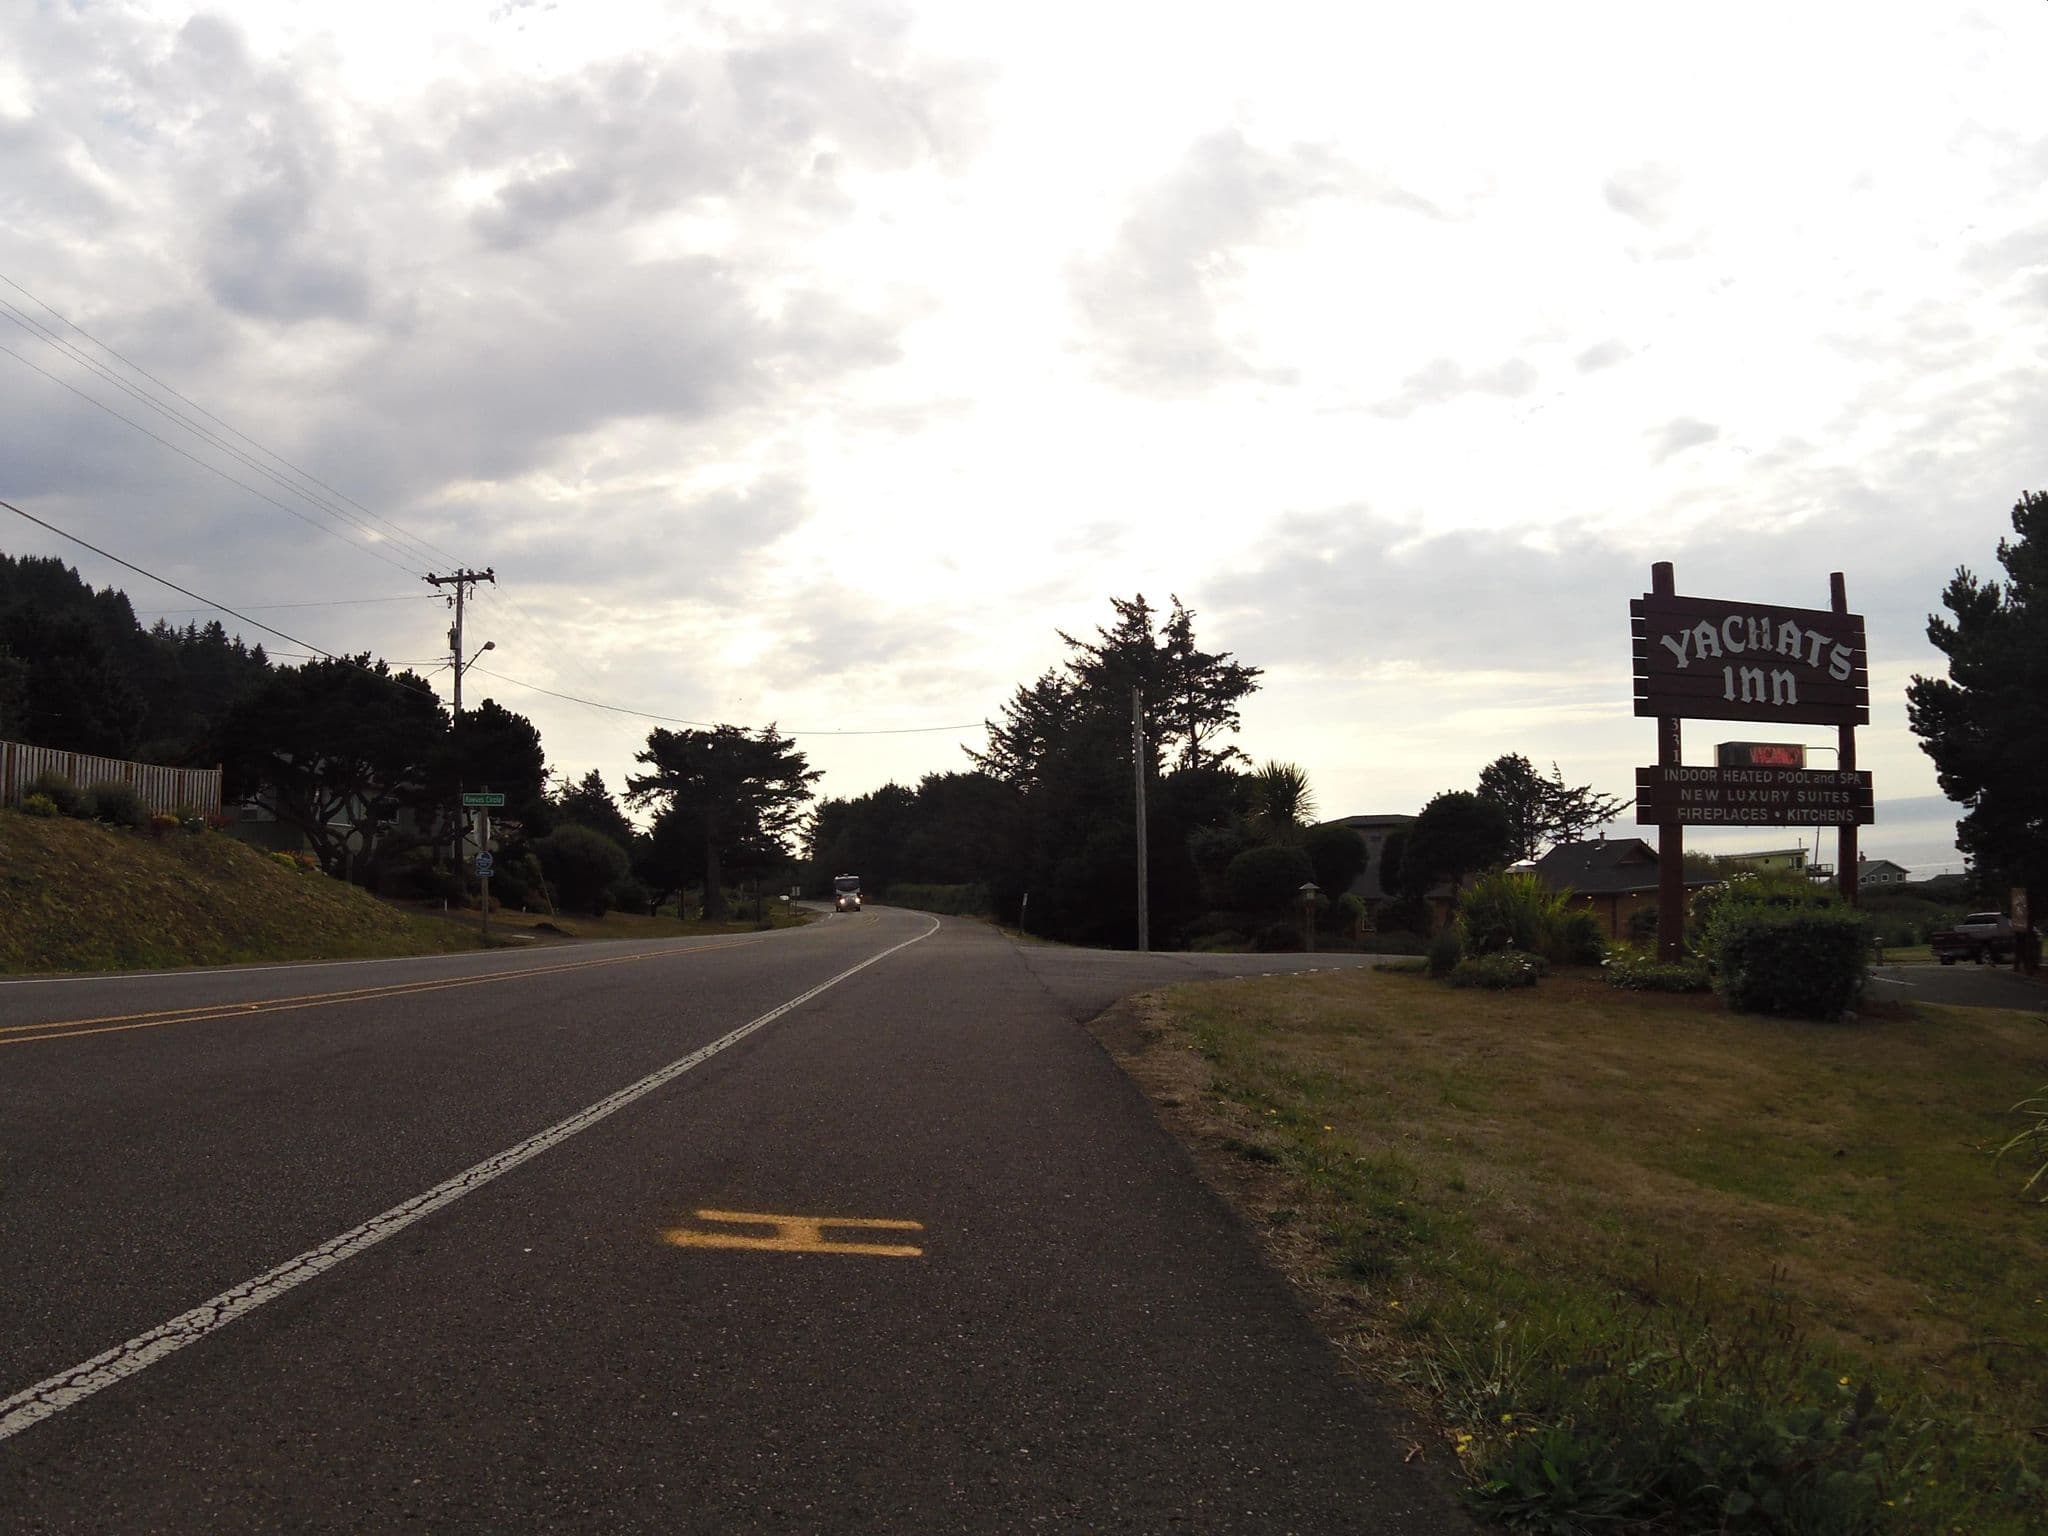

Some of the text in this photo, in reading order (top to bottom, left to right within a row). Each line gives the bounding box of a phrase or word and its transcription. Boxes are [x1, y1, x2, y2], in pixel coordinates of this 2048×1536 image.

[1660, 615, 1854, 681] YACHATS
[1664, 769, 1861, 784] INDOOR HEATED POOL and SPA
[1681, 789, 1849, 803] NEW LUXURY SUITES
[1678, 808, 1854, 821] FIREPLACES KITCHENS
